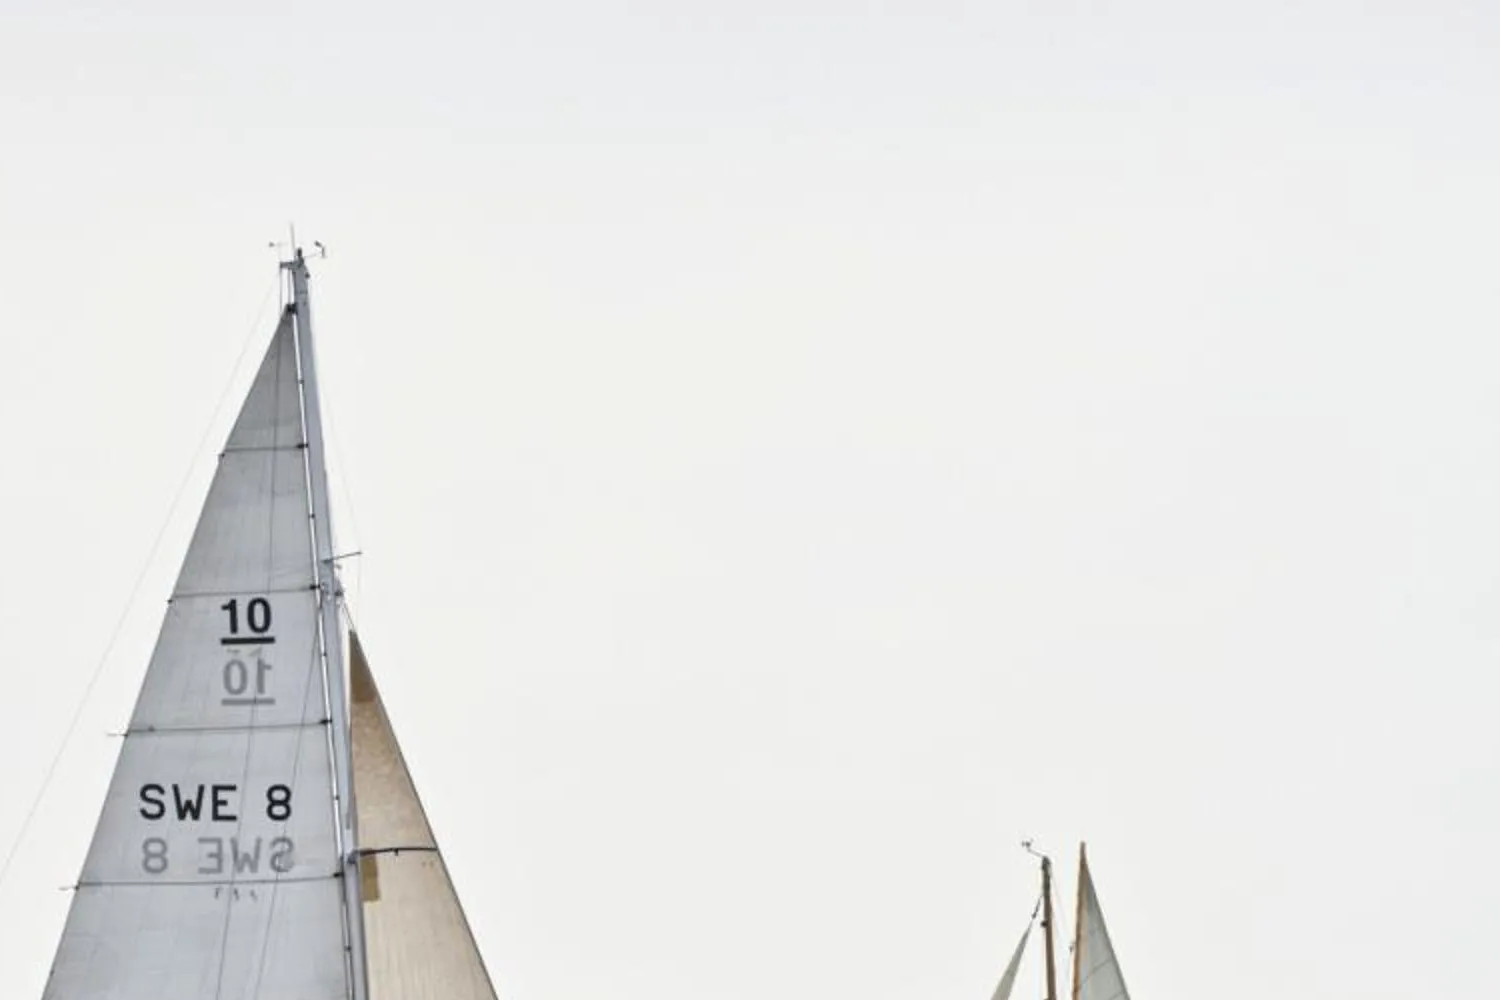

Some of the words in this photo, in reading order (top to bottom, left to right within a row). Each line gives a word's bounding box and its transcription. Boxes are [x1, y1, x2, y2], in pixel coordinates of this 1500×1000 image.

[220, 597, 272, 634] 10
[139, 783, 238, 822] SWE
[266, 784, 292, 822] 8
